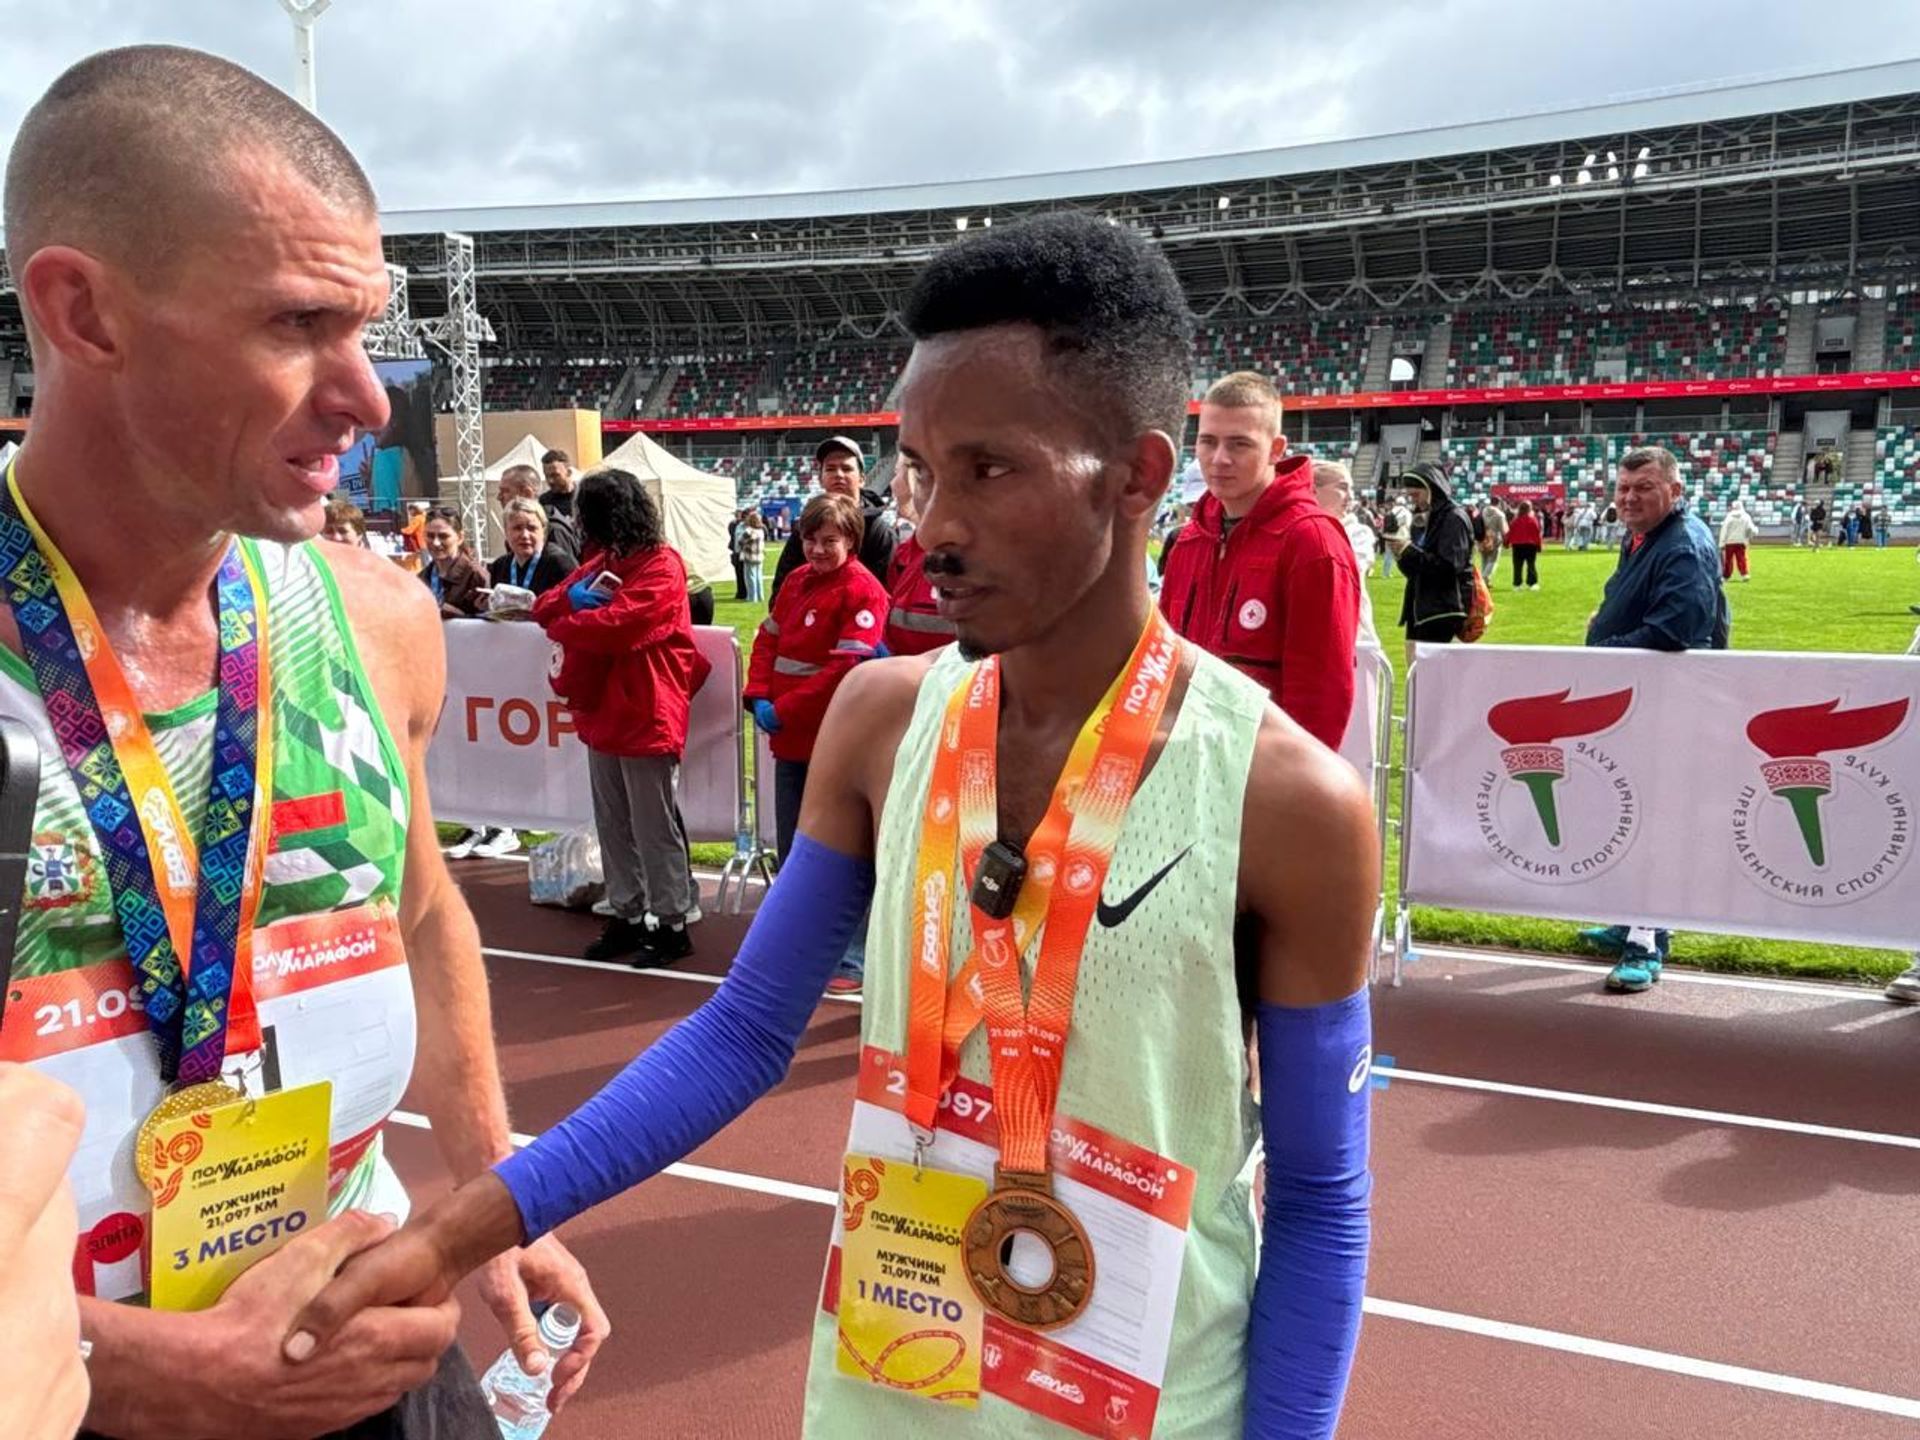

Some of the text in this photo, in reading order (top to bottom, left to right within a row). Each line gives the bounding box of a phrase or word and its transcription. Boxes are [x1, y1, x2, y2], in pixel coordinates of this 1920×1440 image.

[1476, 742, 1633, 876] ПРЕЗИДЕНТСКИЙ СПОРТИВНЫЙ КЛУБ
[1733, 755, 1907, 897] ПРЕЗИДЕНТСКИЙ СПОРТИВНЫЙ КЛУБ
[34, 985, 146, 1036] 21.09
[200, 1183, 285, 1218] МУЖЧИНЫ
[206, 1199, 278, 1229] 21,097 КМ
[173, 1210, 307, 1270] 3 МЕСТО
[876, 1249, 946, 1275] МУЖЧИНЫ
[881, 1264, 941, 1286] 21,097 КМ
[858, 1279, 963, 1322] 1 МЕСТО
